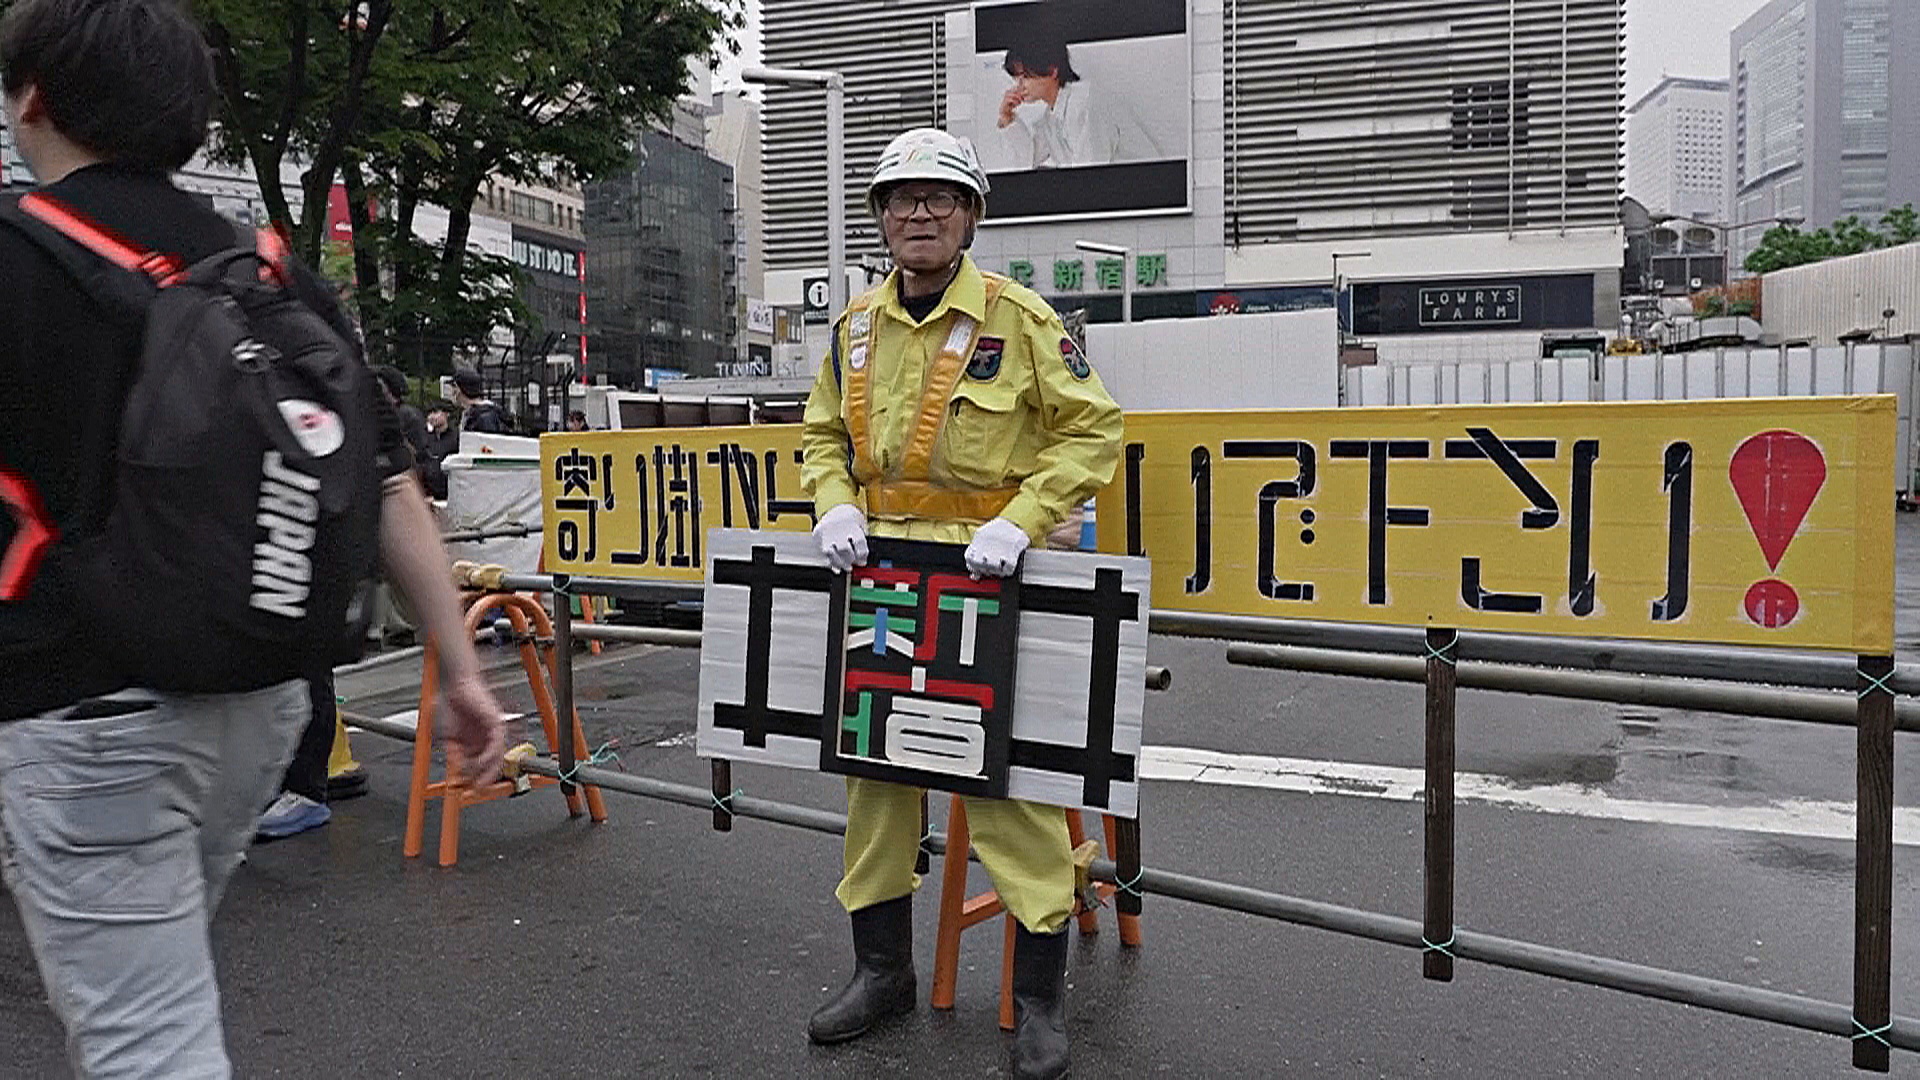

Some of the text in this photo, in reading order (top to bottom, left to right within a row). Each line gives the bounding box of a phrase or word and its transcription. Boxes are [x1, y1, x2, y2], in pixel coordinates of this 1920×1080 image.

[1424, 290, 1516, 306] LOWRYS
[1432, 306, 1508, 320] FARM
[249, 449, 322, 619] JAPAN
